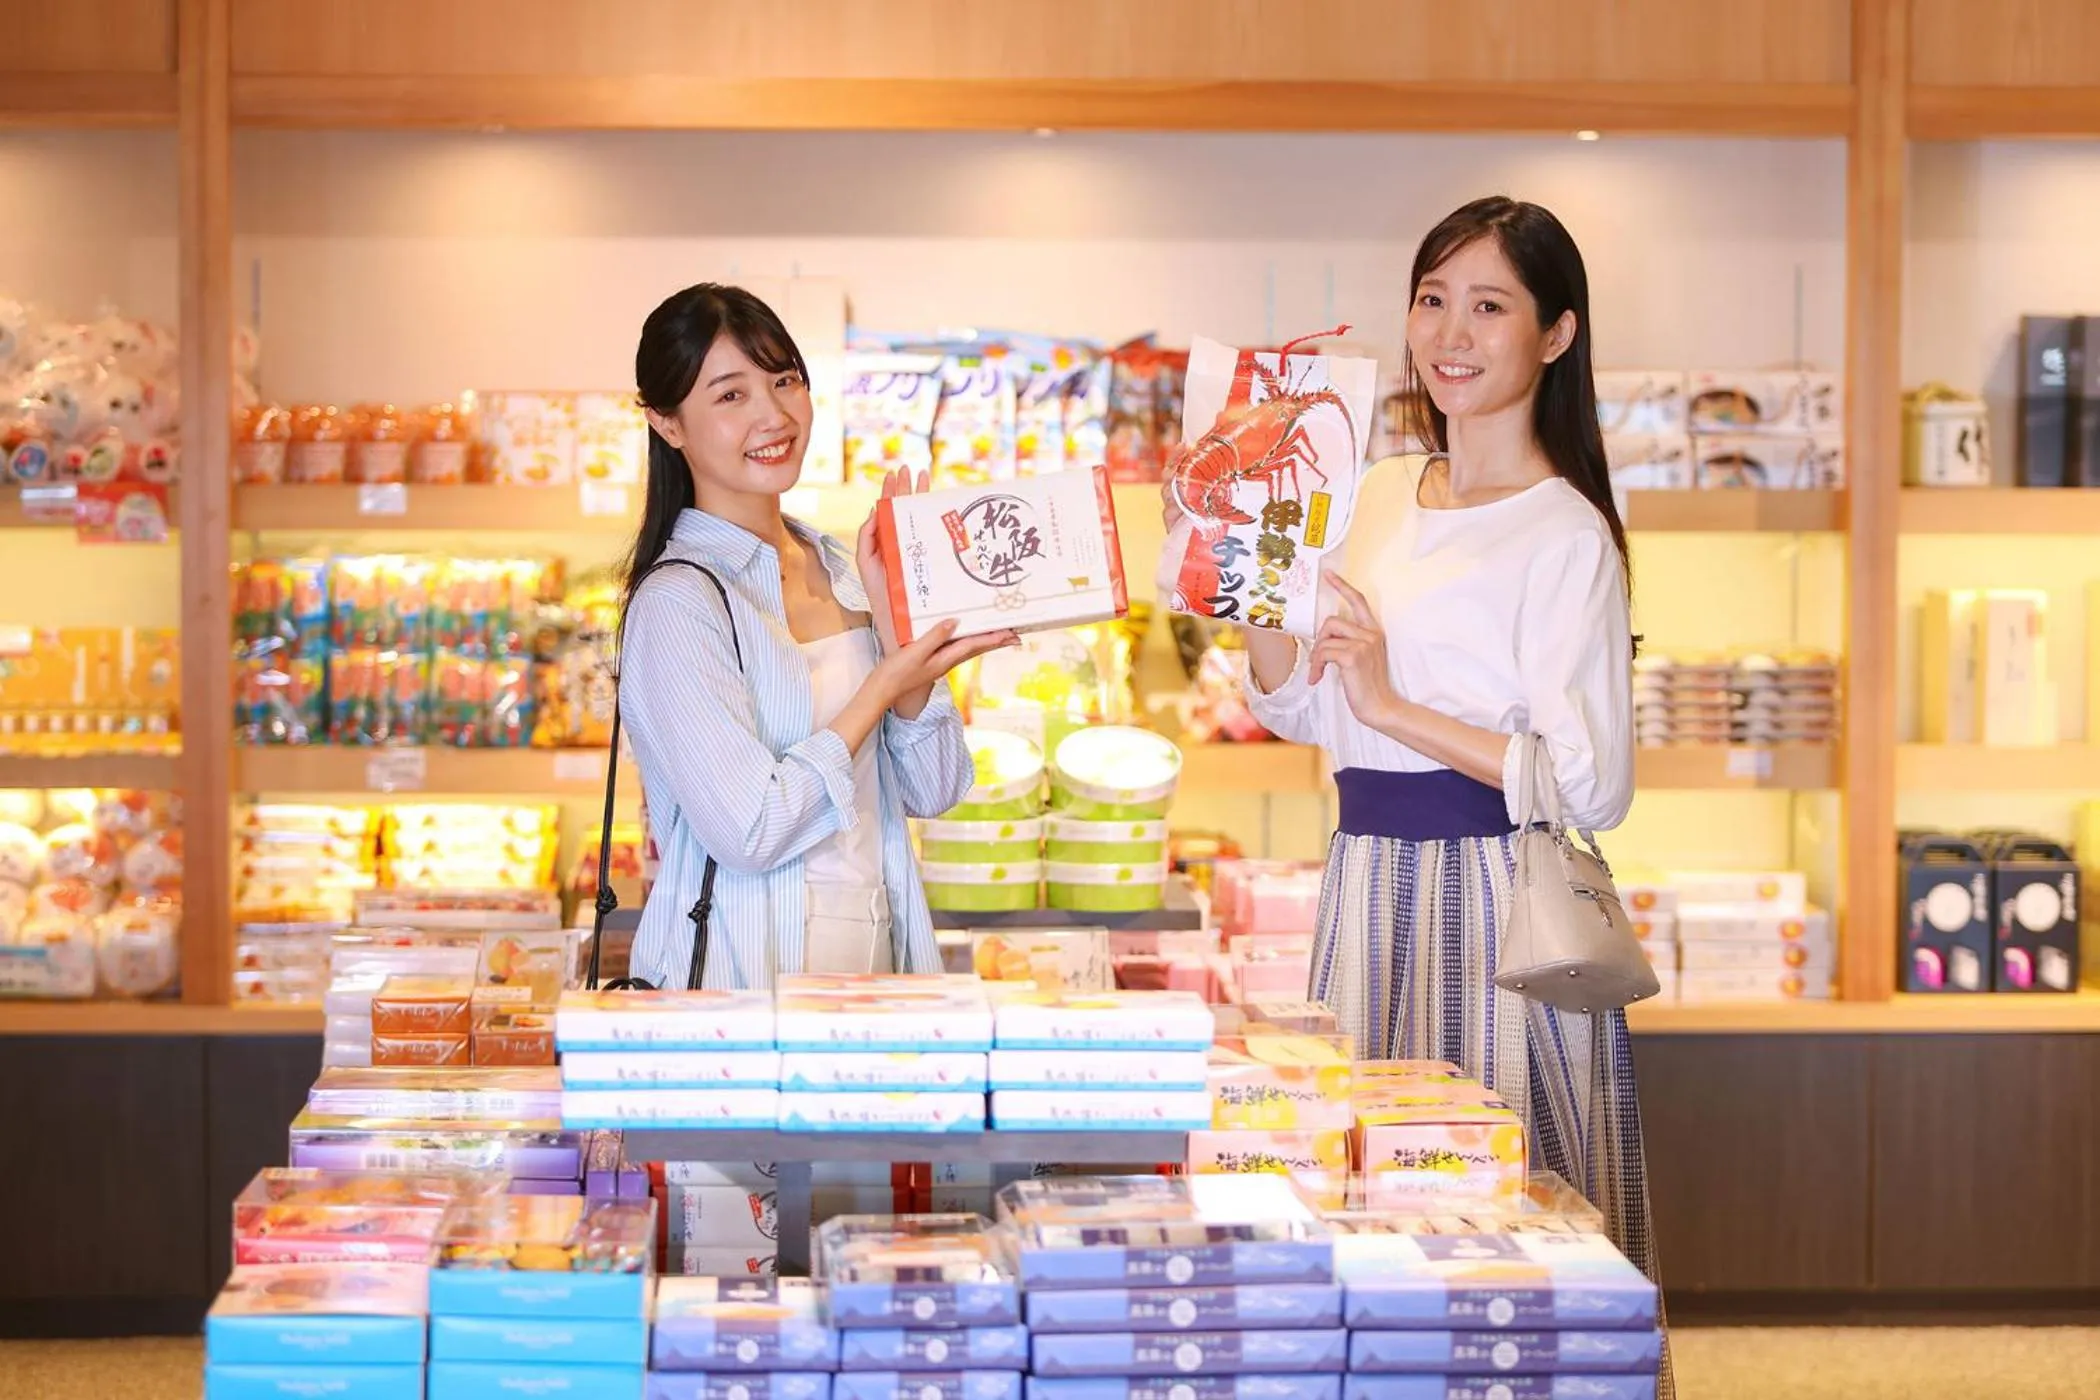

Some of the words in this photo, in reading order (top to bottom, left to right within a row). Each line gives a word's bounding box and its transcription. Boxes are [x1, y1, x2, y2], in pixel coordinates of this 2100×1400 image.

[982, 501, 1047, 583] 松阪牛
[1392, 1148, 1500, 1171] 海鮮せんべい
